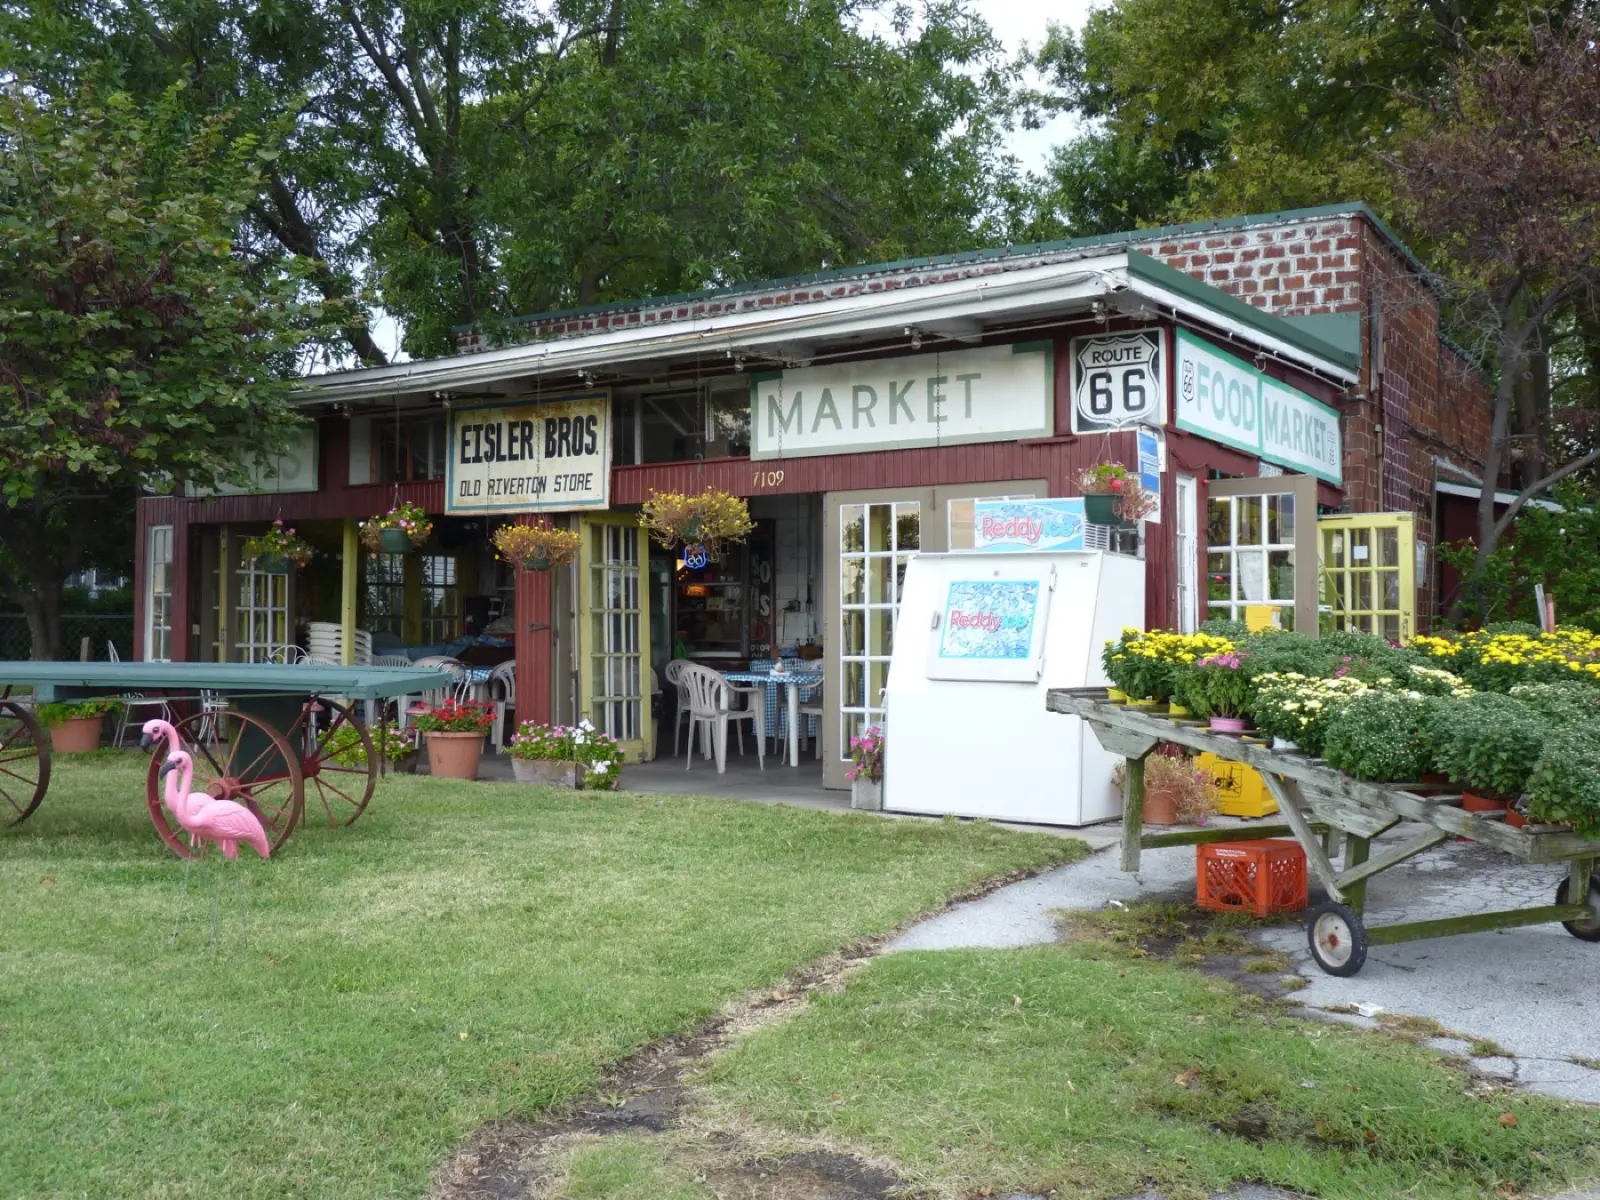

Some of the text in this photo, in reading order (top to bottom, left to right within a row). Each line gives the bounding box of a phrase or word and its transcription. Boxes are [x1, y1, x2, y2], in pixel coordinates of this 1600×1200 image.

[1092, 347, 1142, 363] ROUTE
[1089, 368, 1146, 415] 66
[767, 373, 982, 438] MARKET
[1197, 362, 1256, 432] FOOD
[1264, 397, 1326, 462] MARKET
[460, 414, 599, 464] EISLER BROS.
[460, 473, 593, 497] OLD RIVERTON STORE
[752, 470, 784, 488] 7109
[982, 516, 1043, 543] Reddy
[950, 610, 1003, 632] Reddy
